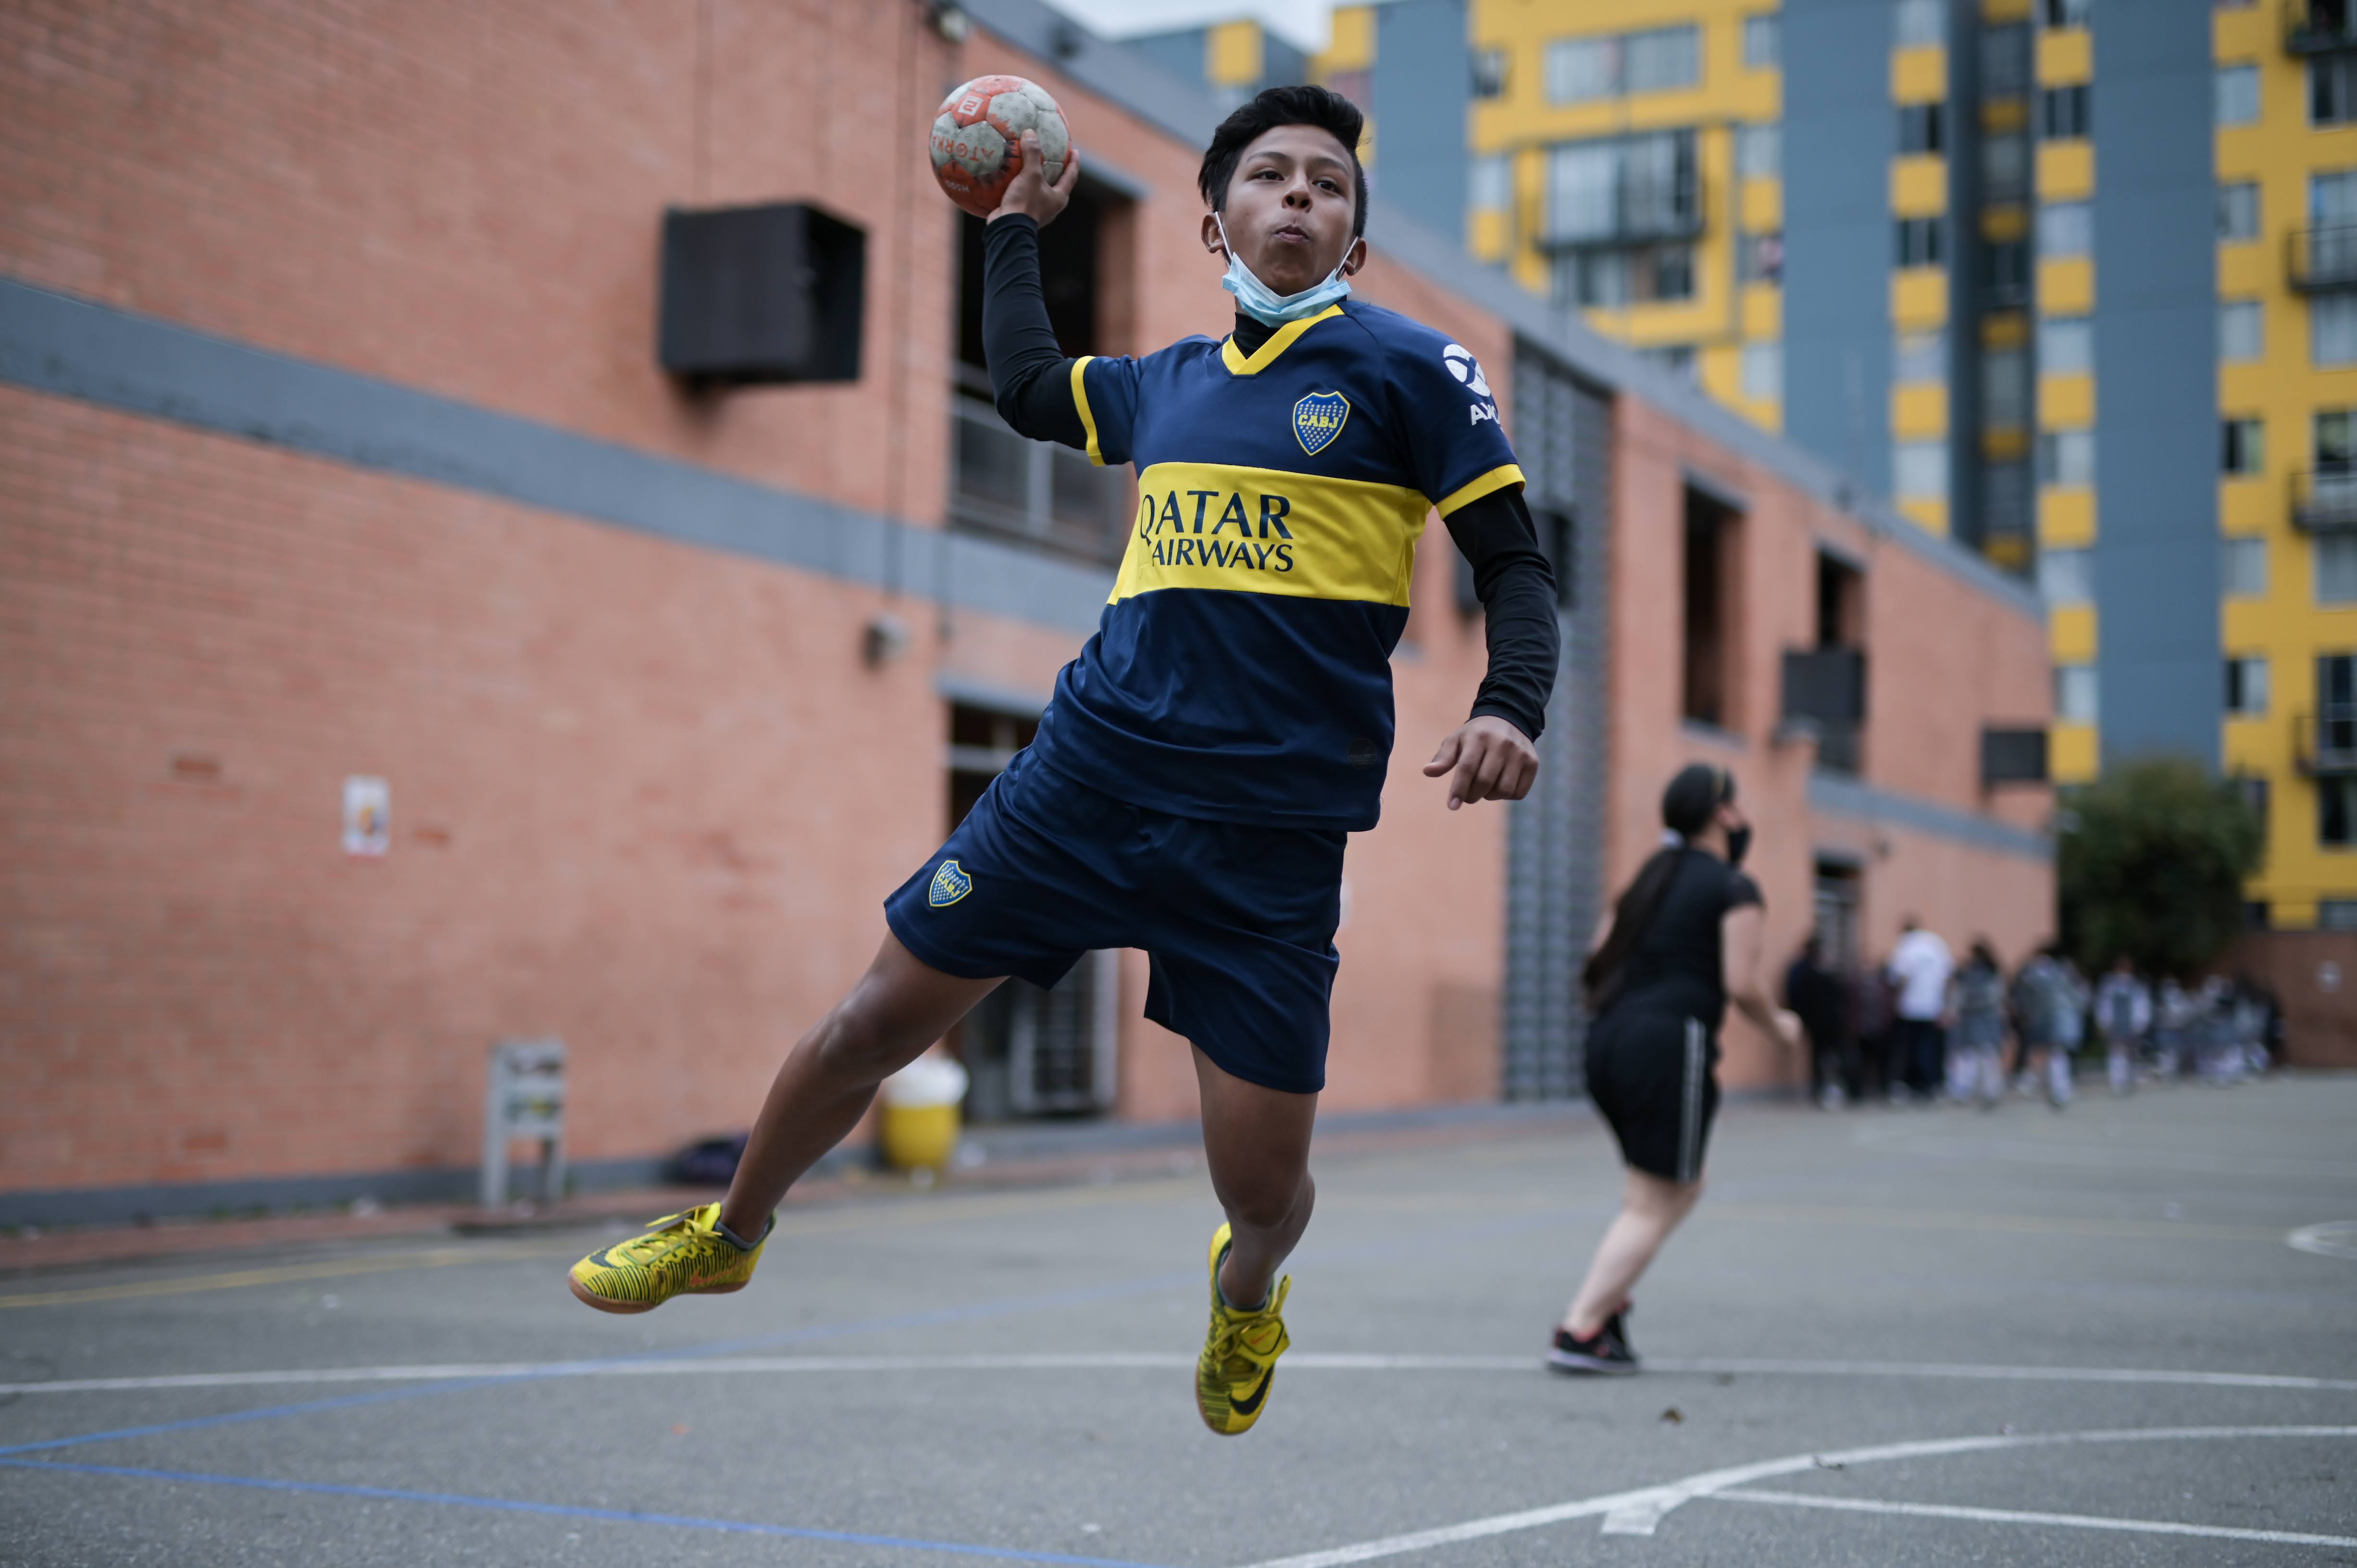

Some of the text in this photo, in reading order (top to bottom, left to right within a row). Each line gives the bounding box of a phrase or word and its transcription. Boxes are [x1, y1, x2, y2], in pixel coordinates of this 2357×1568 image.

[1298, 414, 1339, 428] CABJ
[1140, 490, 1294, 547] QATAR
[1152, 538, 1294, 572] AIRWAYS
[937, 872, 960, 897] CABJ
